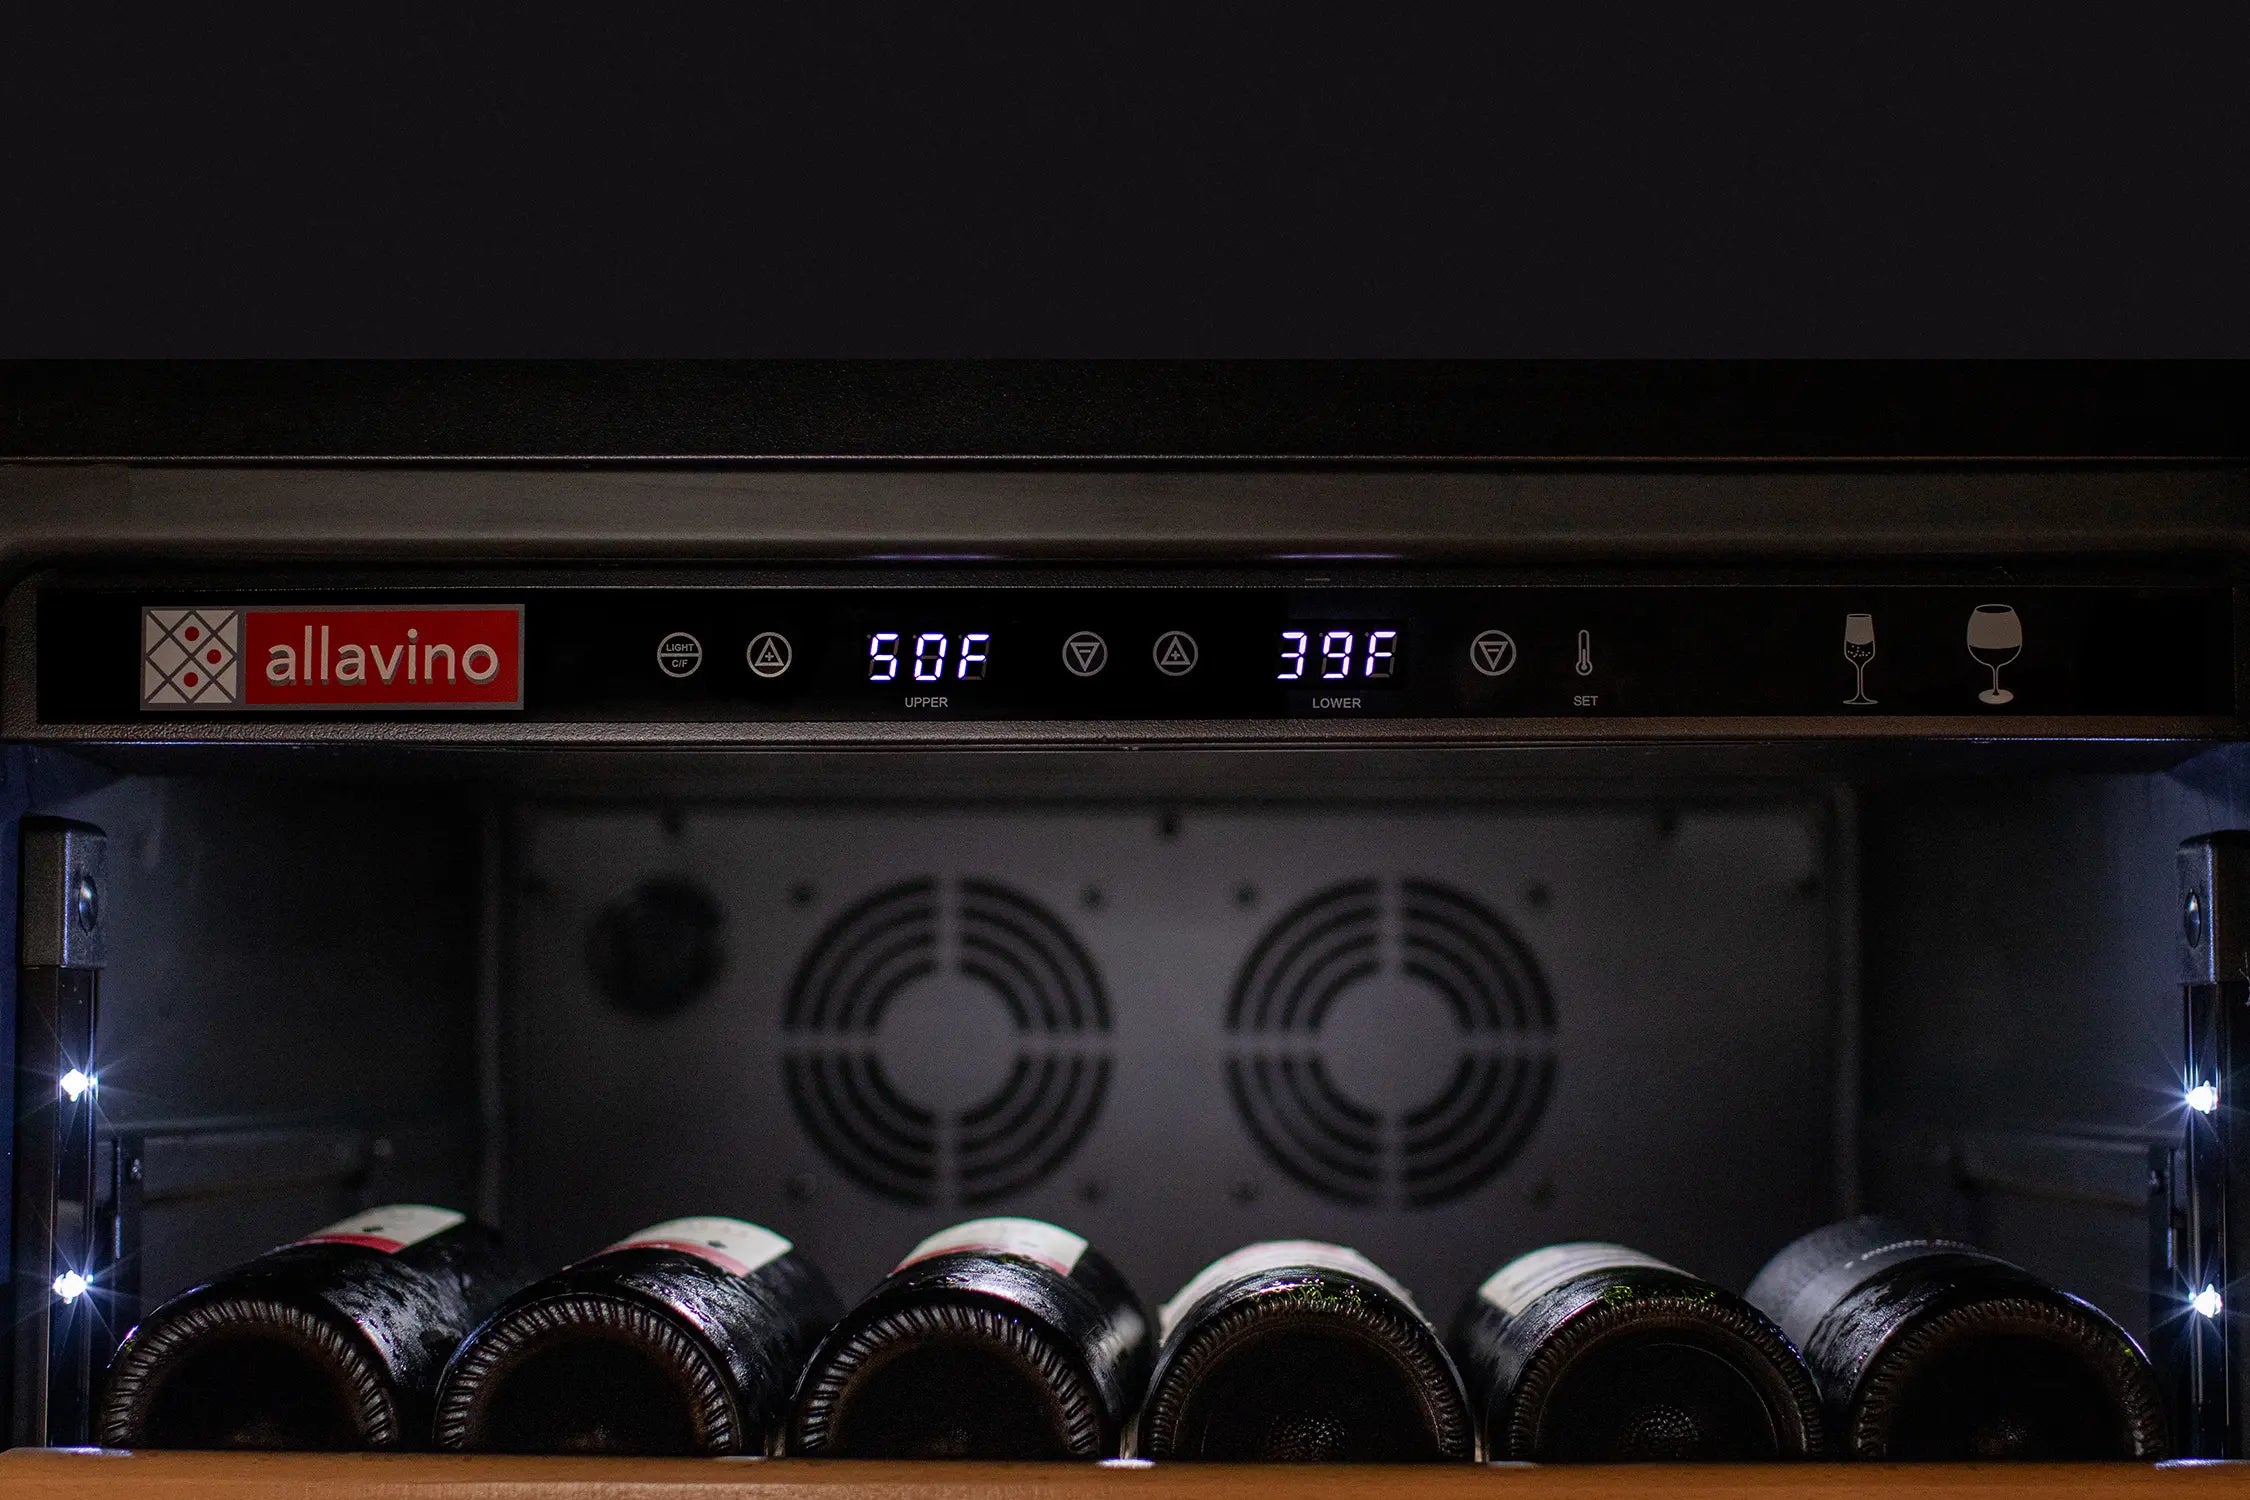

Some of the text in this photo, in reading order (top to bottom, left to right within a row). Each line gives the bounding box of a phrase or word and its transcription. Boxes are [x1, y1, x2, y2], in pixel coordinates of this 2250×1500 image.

[666, 643, 694, 652] LIGHT
[265, 625, 499, 682] allavino
[1277, 631, 1396, 680] 39F
[672, 659, 688, 668] C/F
[905, 697, 948, 708] UPPER
[1312, 697, 1361, 709] LOWER
[1573, 696, 1599, 706] SET
